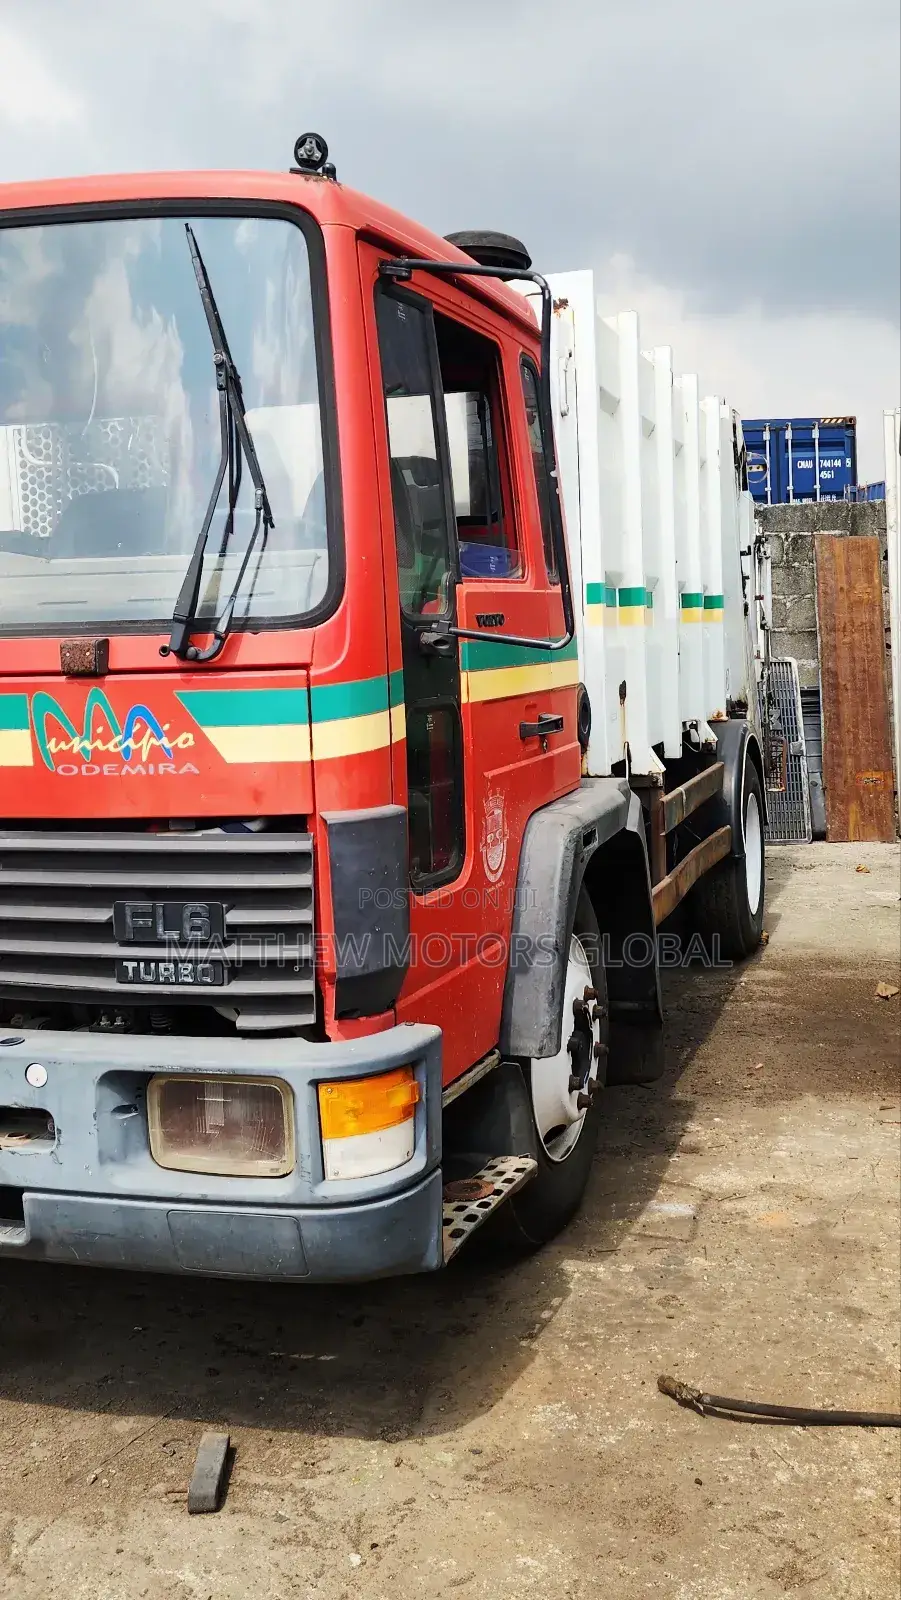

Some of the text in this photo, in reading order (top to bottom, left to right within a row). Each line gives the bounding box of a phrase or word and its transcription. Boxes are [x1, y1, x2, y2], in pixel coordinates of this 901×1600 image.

[820, 459, 841, 467] 744144
[57, 763, 200, 776] ODEMIRA
[125, 903, 211, 940] FL6
[122, 961, 215, 983] TURBO
